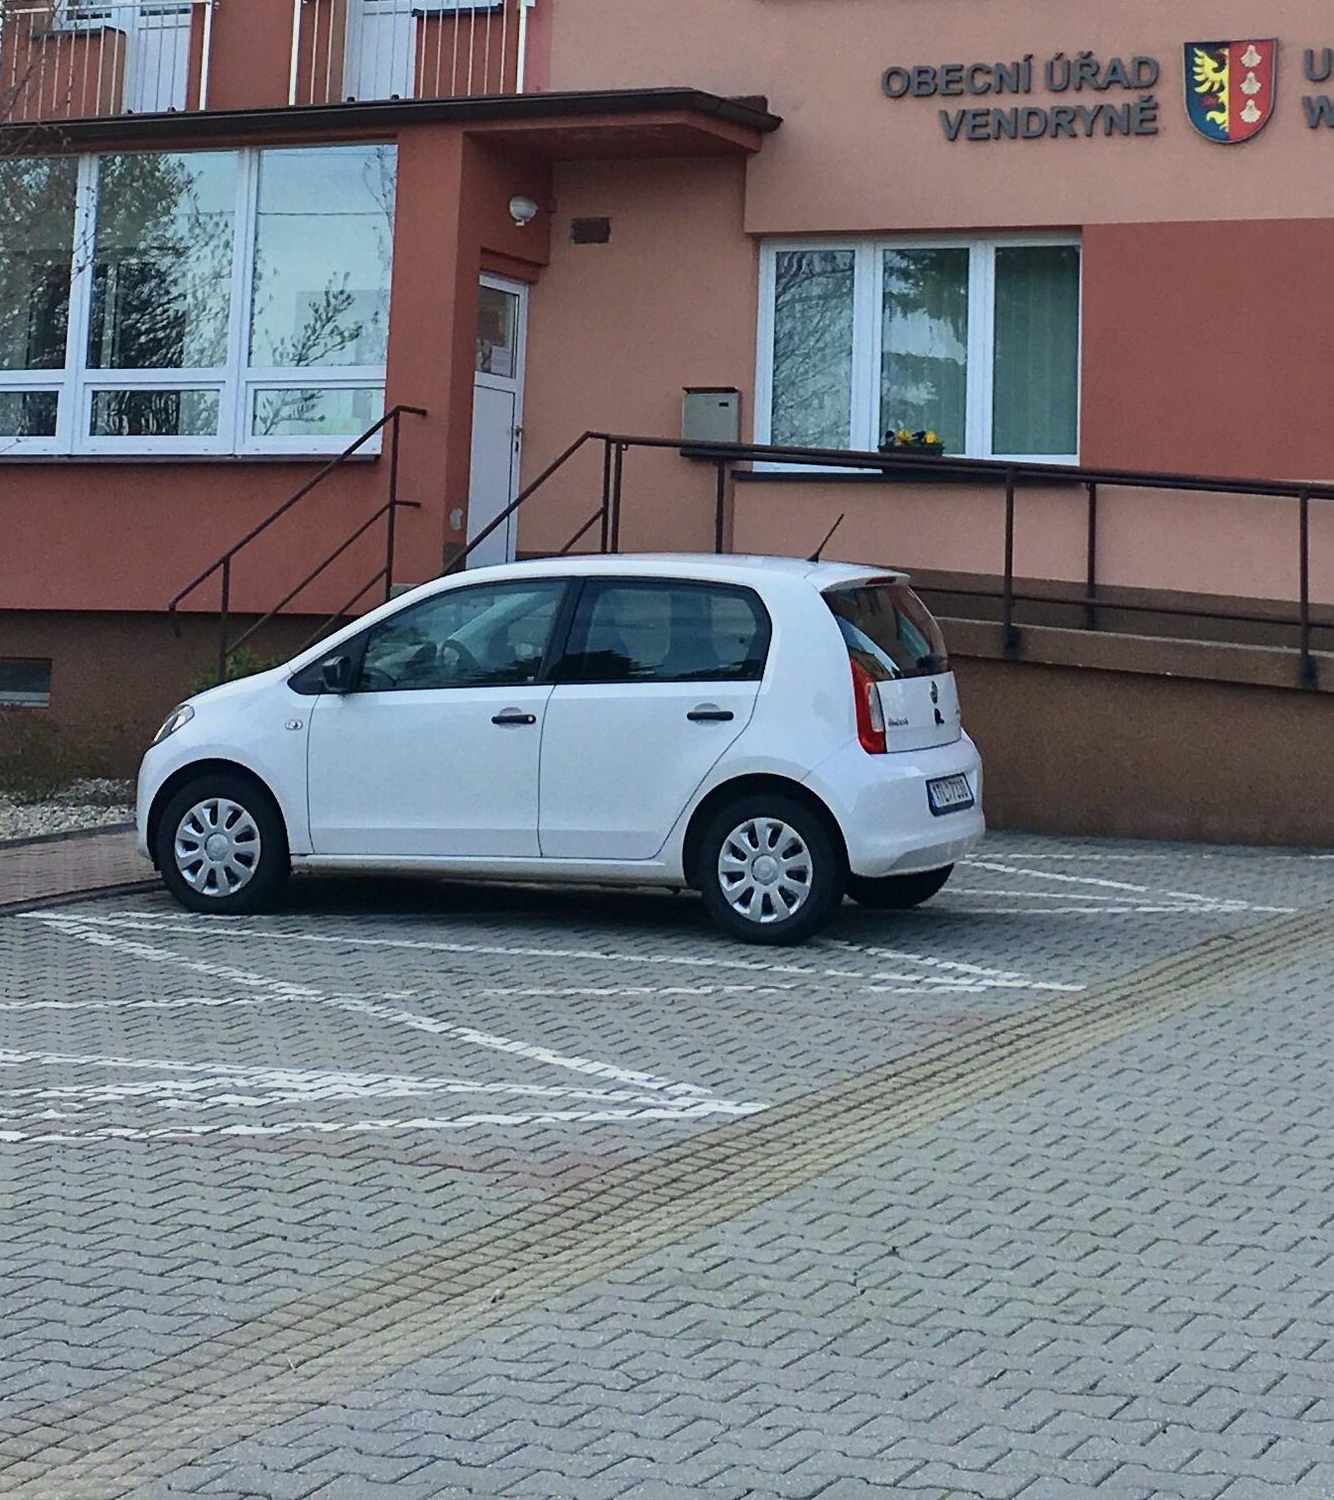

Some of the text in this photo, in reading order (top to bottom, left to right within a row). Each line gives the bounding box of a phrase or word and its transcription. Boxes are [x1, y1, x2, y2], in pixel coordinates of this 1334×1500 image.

[881, 51, 1159, 98] OBECNÍ ÚŘAD
[939, 95, 1159, 141] VENDRYNĚ
